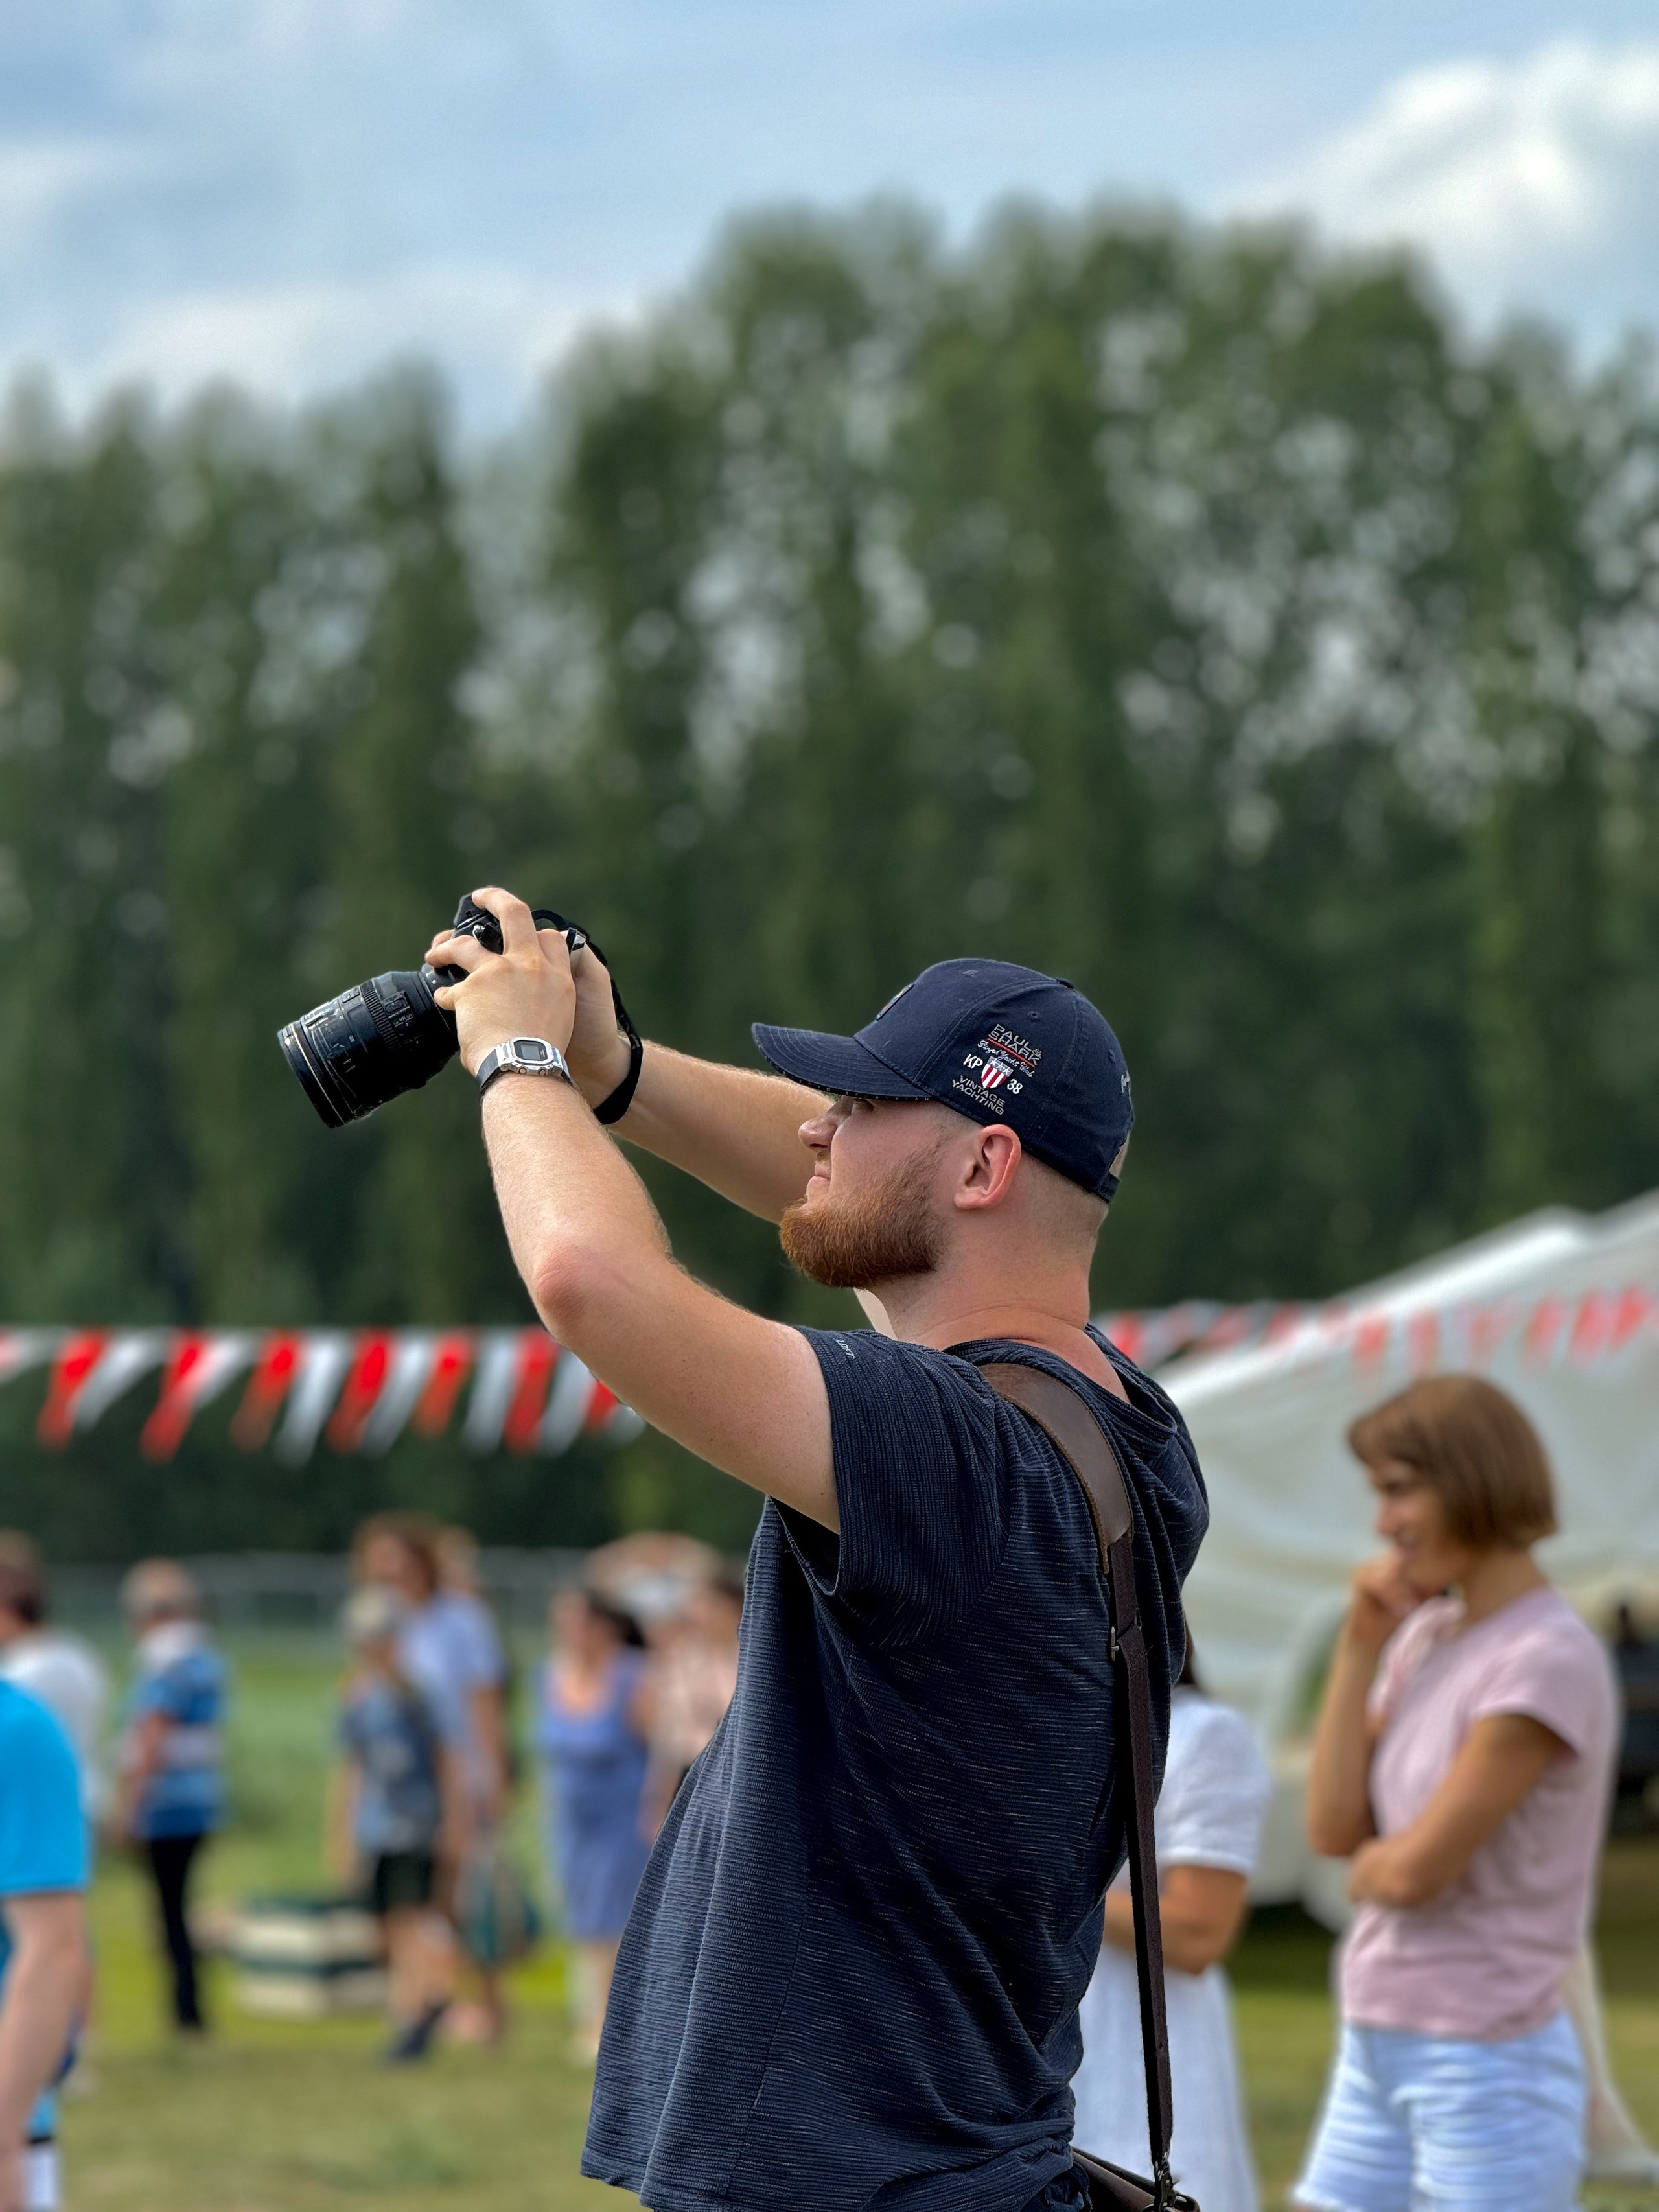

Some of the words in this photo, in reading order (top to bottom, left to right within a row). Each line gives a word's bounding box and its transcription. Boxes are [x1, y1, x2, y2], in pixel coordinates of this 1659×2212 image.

[963, 1053, 983, 1069] KP
[988, 1030, 1040, 1065] SHARK
[952, 1079, 1004, 1115] YACHTING
[960, 1075, 1006, 1108] VINTAGE
[1007, 1078, 1023, 1095] 38
